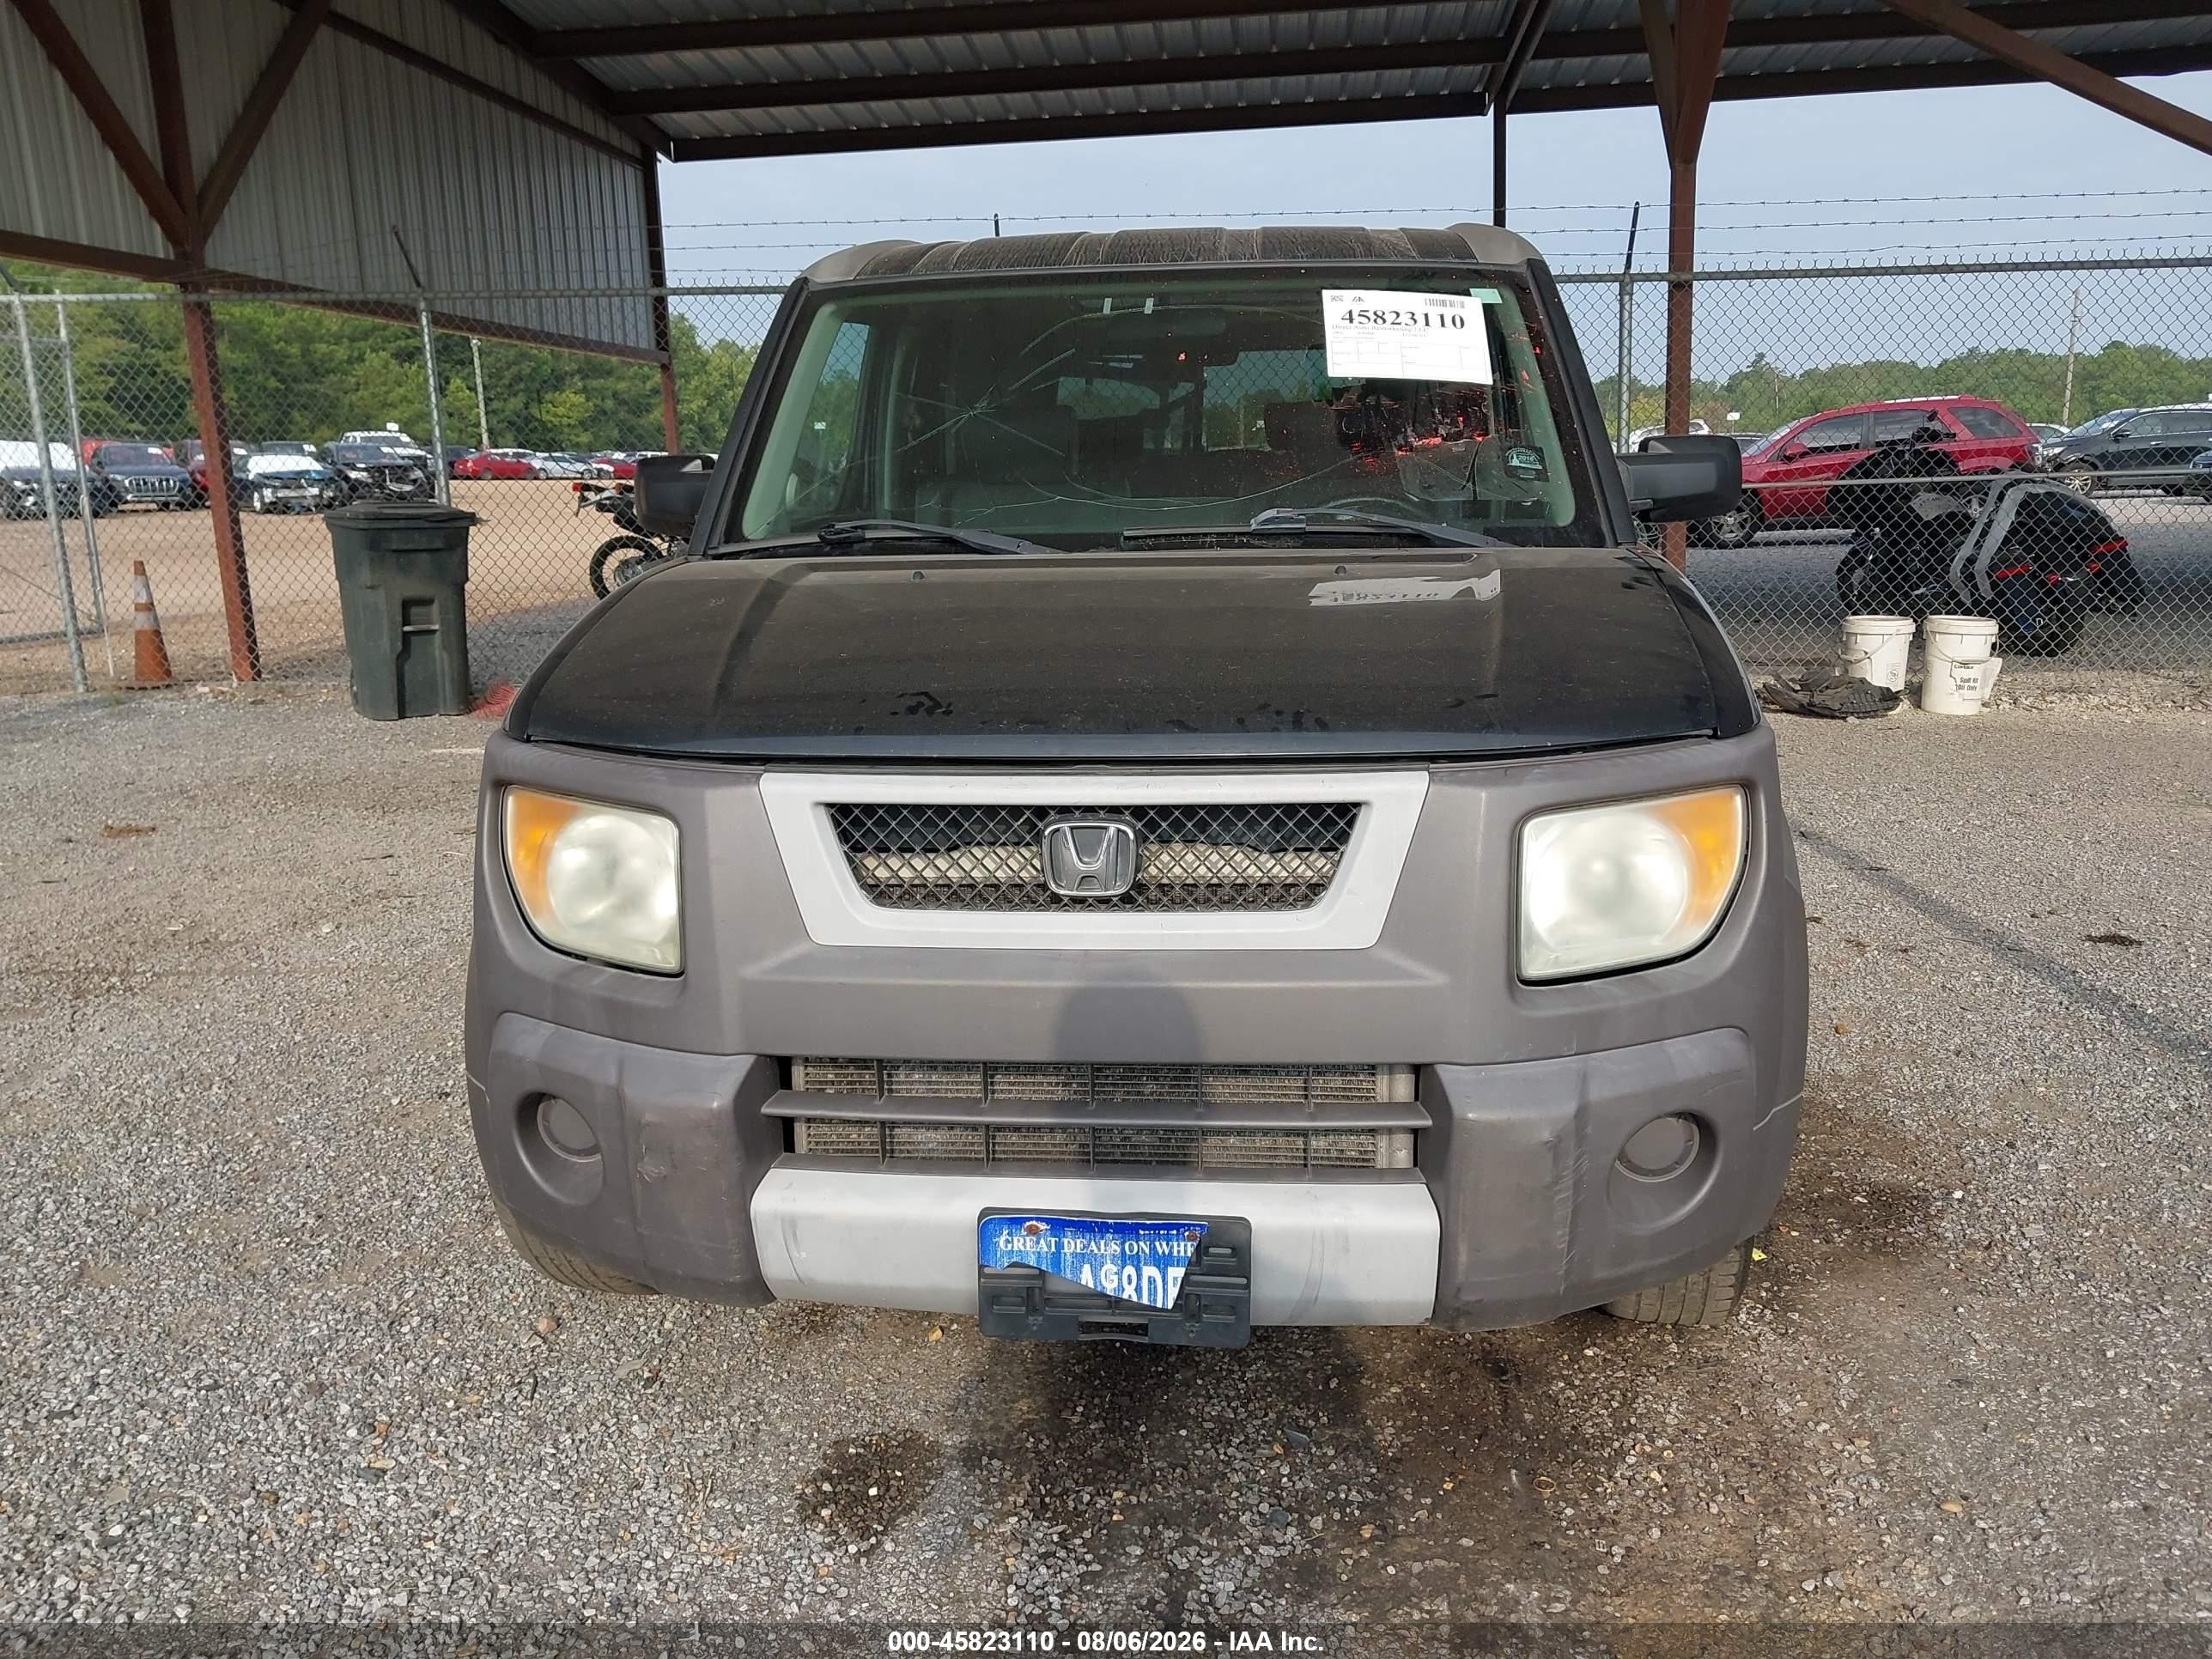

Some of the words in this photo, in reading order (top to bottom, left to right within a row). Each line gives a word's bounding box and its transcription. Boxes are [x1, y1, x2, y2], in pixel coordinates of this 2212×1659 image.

[1340, 309, 1465, 330] 45823110
[999, 1236, 1059, 1251] GREAT
[1062, 1239, 1121, 1254] DEALS
[1125, 1241, 1150, 1255] ON
